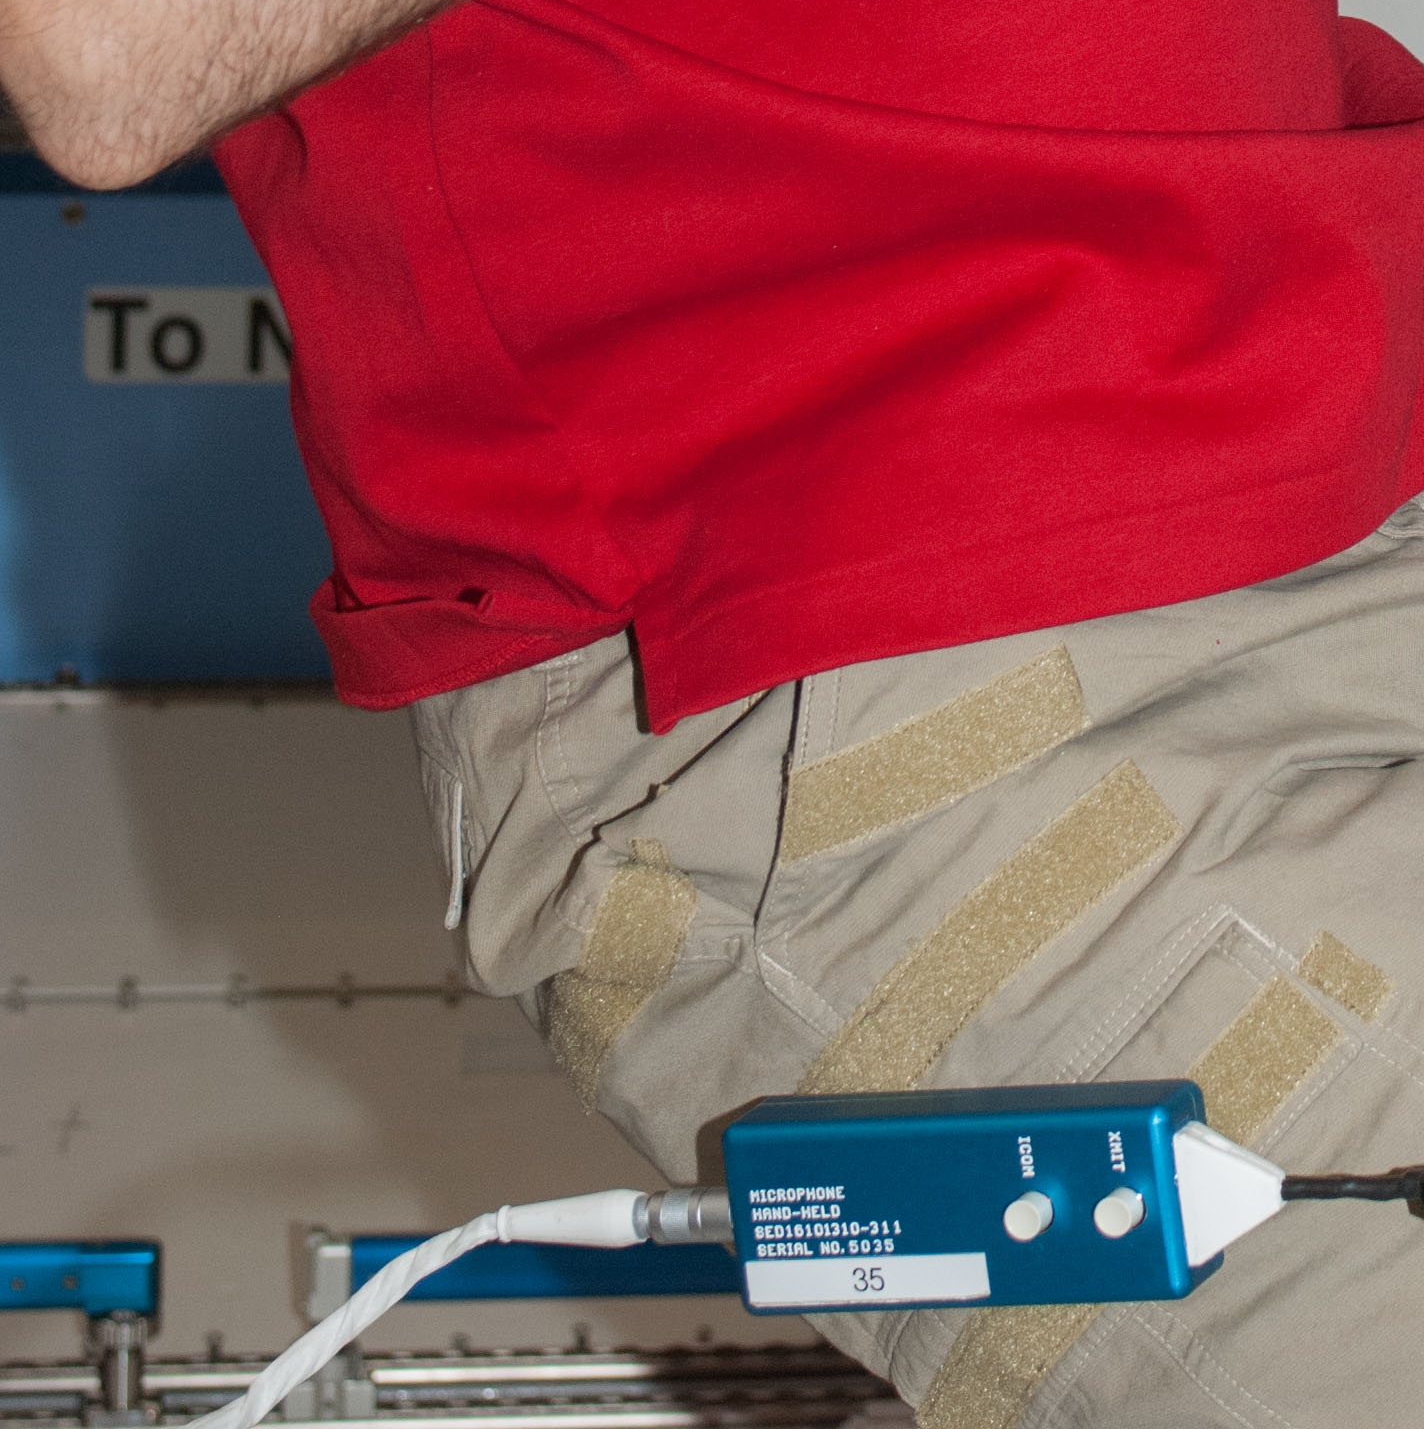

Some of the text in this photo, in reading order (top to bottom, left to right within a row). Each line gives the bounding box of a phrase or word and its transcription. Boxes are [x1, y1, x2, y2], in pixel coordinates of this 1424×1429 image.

[91, 296, 204, 373] To
[1017, 1135, 1036, 1179] ICOM
[1107, 1130, 1126, 1173] XMIT
[749, 1185, 846, 1204] MICROPHONE
[752, 1204, 841, 1222] HAND-HELD
[756, 1241, 814, 1258] SERIAL
[851, 1266, 886, 1292] 35
